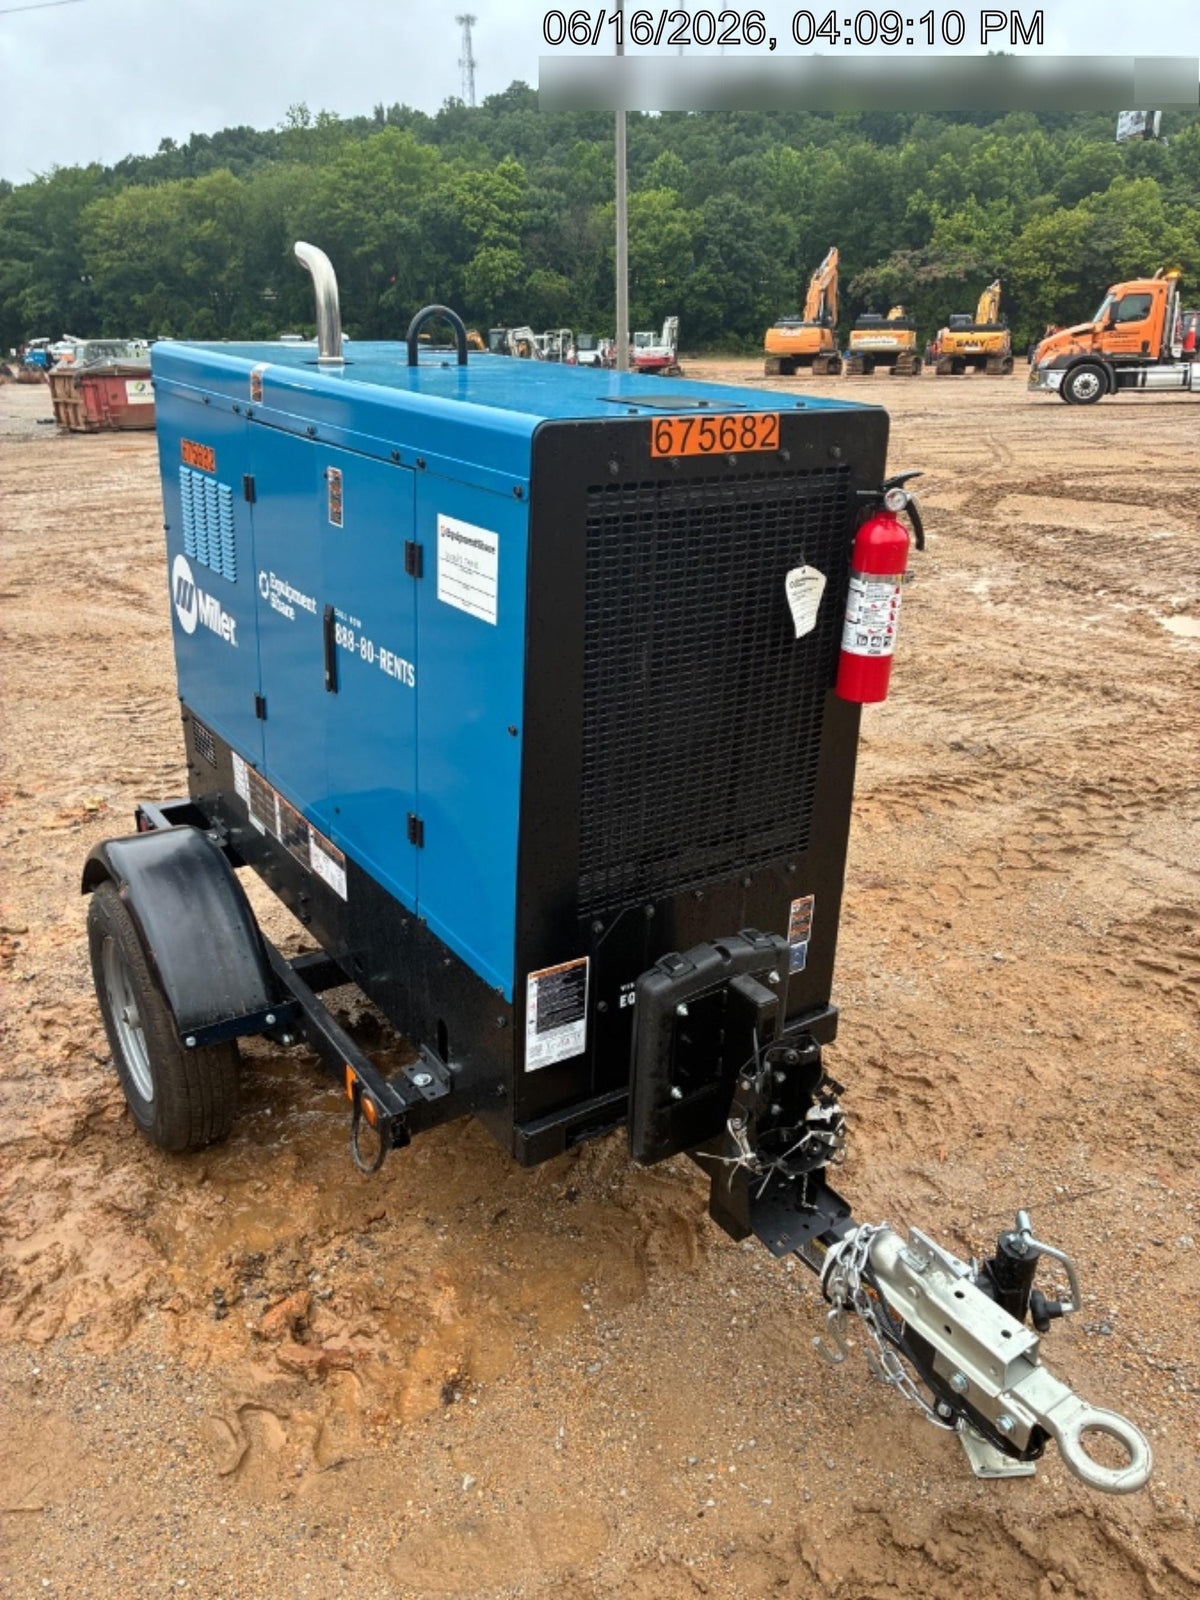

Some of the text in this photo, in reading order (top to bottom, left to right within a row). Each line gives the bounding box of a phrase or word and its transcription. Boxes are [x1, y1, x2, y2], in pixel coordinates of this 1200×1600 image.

[655, 413, 778, 454] 675682
[269, 571, 317, 614] Equipment
[271, 591, 295, 620] Share
[197, 587, 237, 646] Miller
